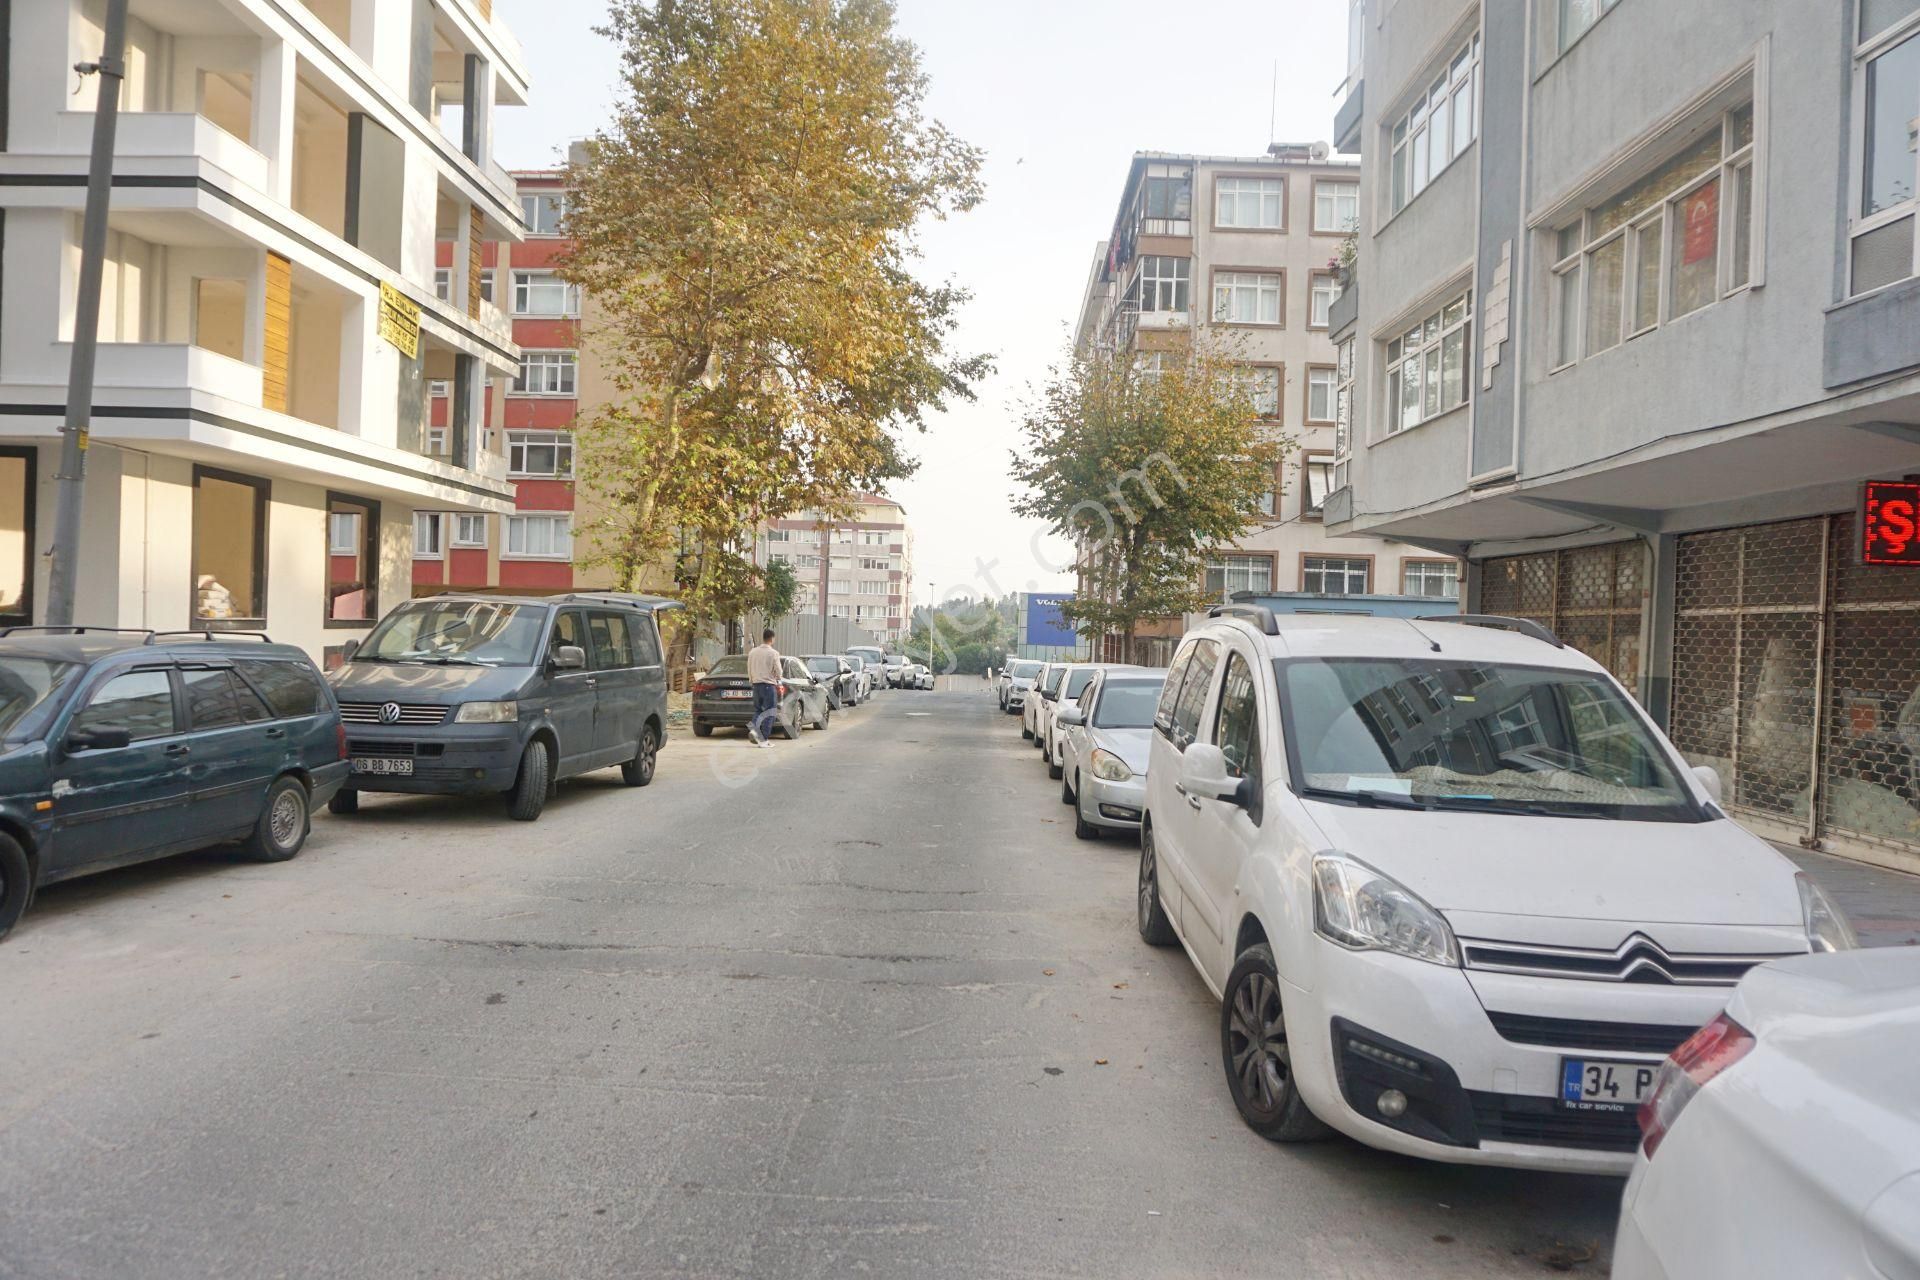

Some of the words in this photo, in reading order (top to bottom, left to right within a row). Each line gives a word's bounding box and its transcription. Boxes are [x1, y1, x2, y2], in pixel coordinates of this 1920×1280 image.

[396, 296, 418, 321] EMLAK
[1879, 499, 1920, 554] Ş
[372, 759, 384, 771] BB
[387, 760, 412, 772] 7653
[1568, 1082, 1581, 1092] TR
[1584, 1066, 1619, 1098] 34
[1635, 1068, 1658, 1099] P
[1579, 1102, 1593, 1110] car
[1595, 1103, 1624, 1112] service
